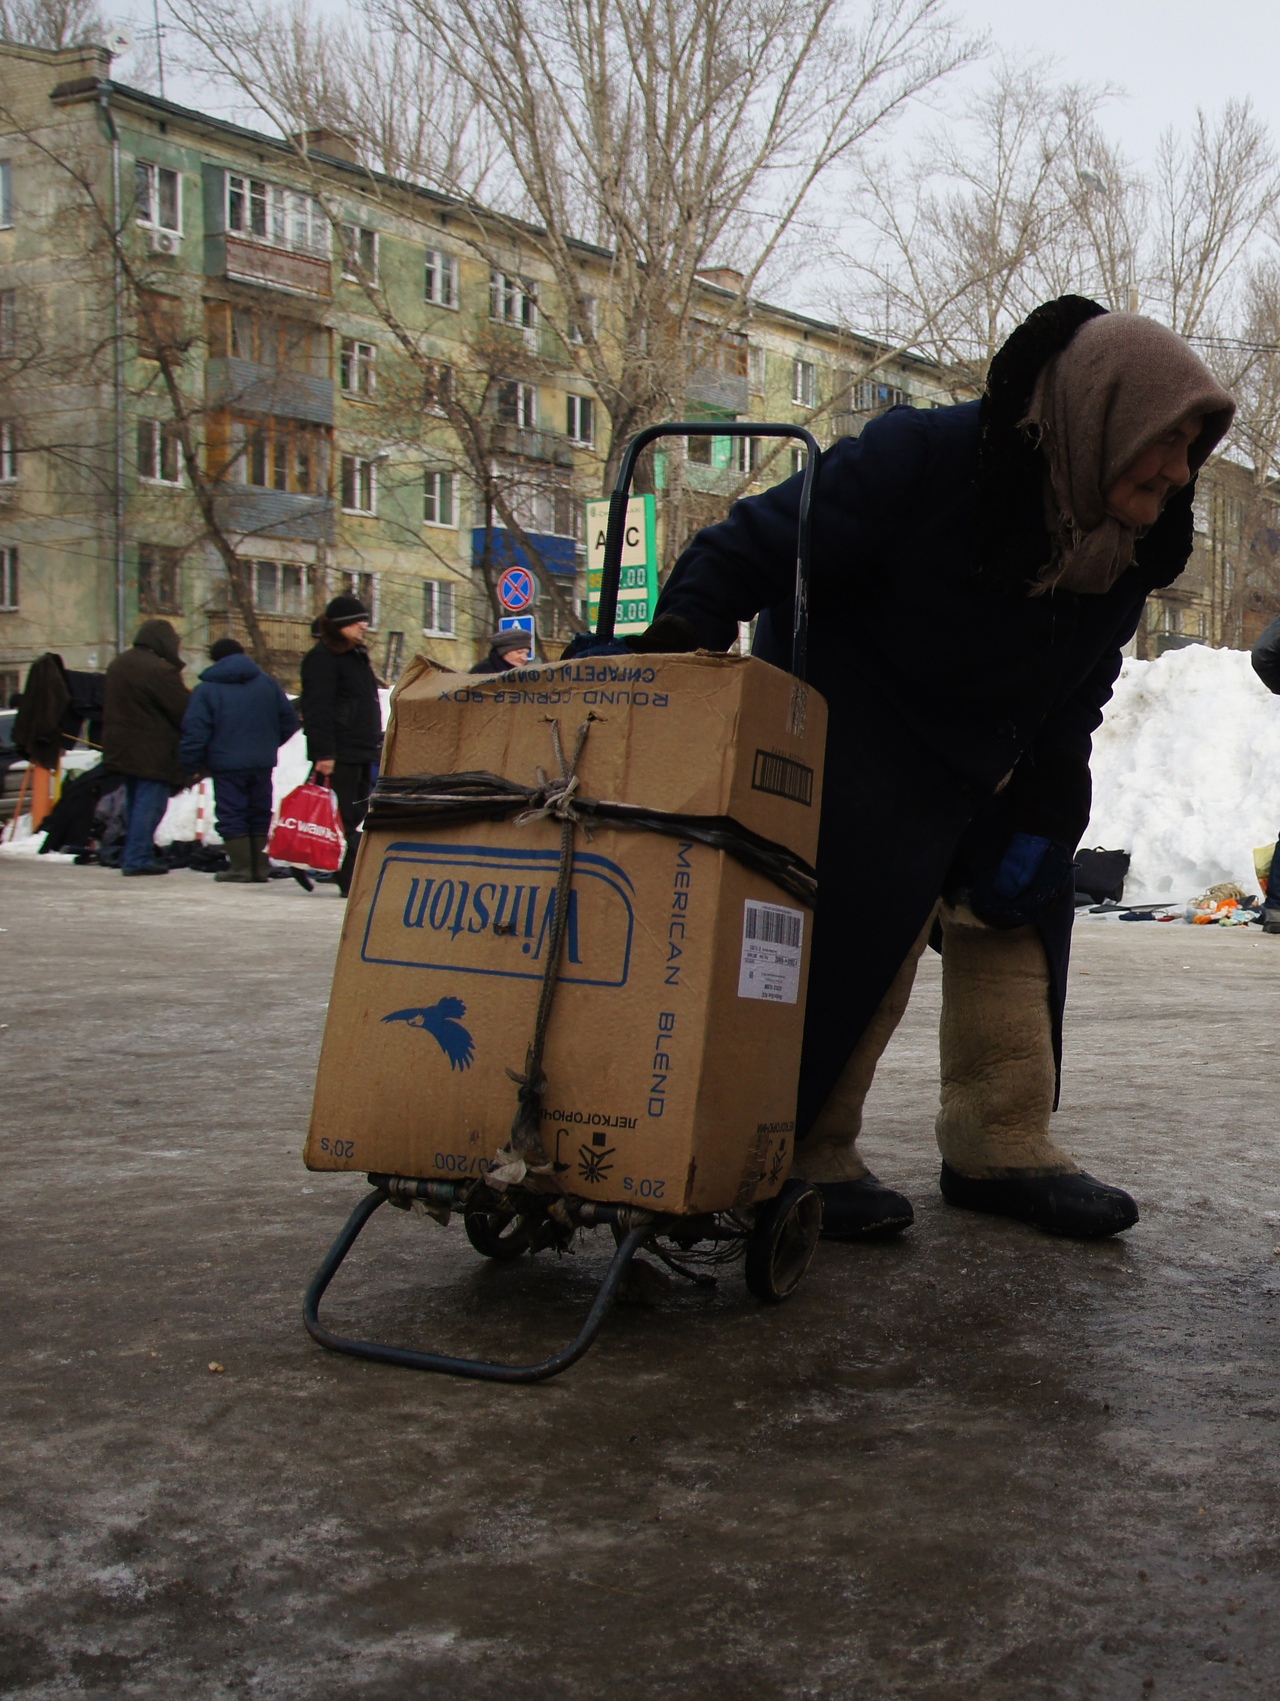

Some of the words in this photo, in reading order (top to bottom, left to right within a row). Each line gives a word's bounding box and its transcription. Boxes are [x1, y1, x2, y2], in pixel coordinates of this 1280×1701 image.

[595, 526, 640, 550] АС
[615, 602, 647, 621] 8.00
[562, 664, 656, 684] СИГАРЕТЫ
[437, 688, 484, 704] BOX
[494, 690, 571, 706] CORNER
[583, 690, 669, 708] ROUND
[403, 877, 583, 965] Winston
[664, 842, 695, 986] MERICAN
[647, 1011, 676, 1118] BLEND
[321, 1137, 355, 1159] 20's
[434, 1153, 498, 1174] 0/200
[623, 1176, 666, 1199] 20's
